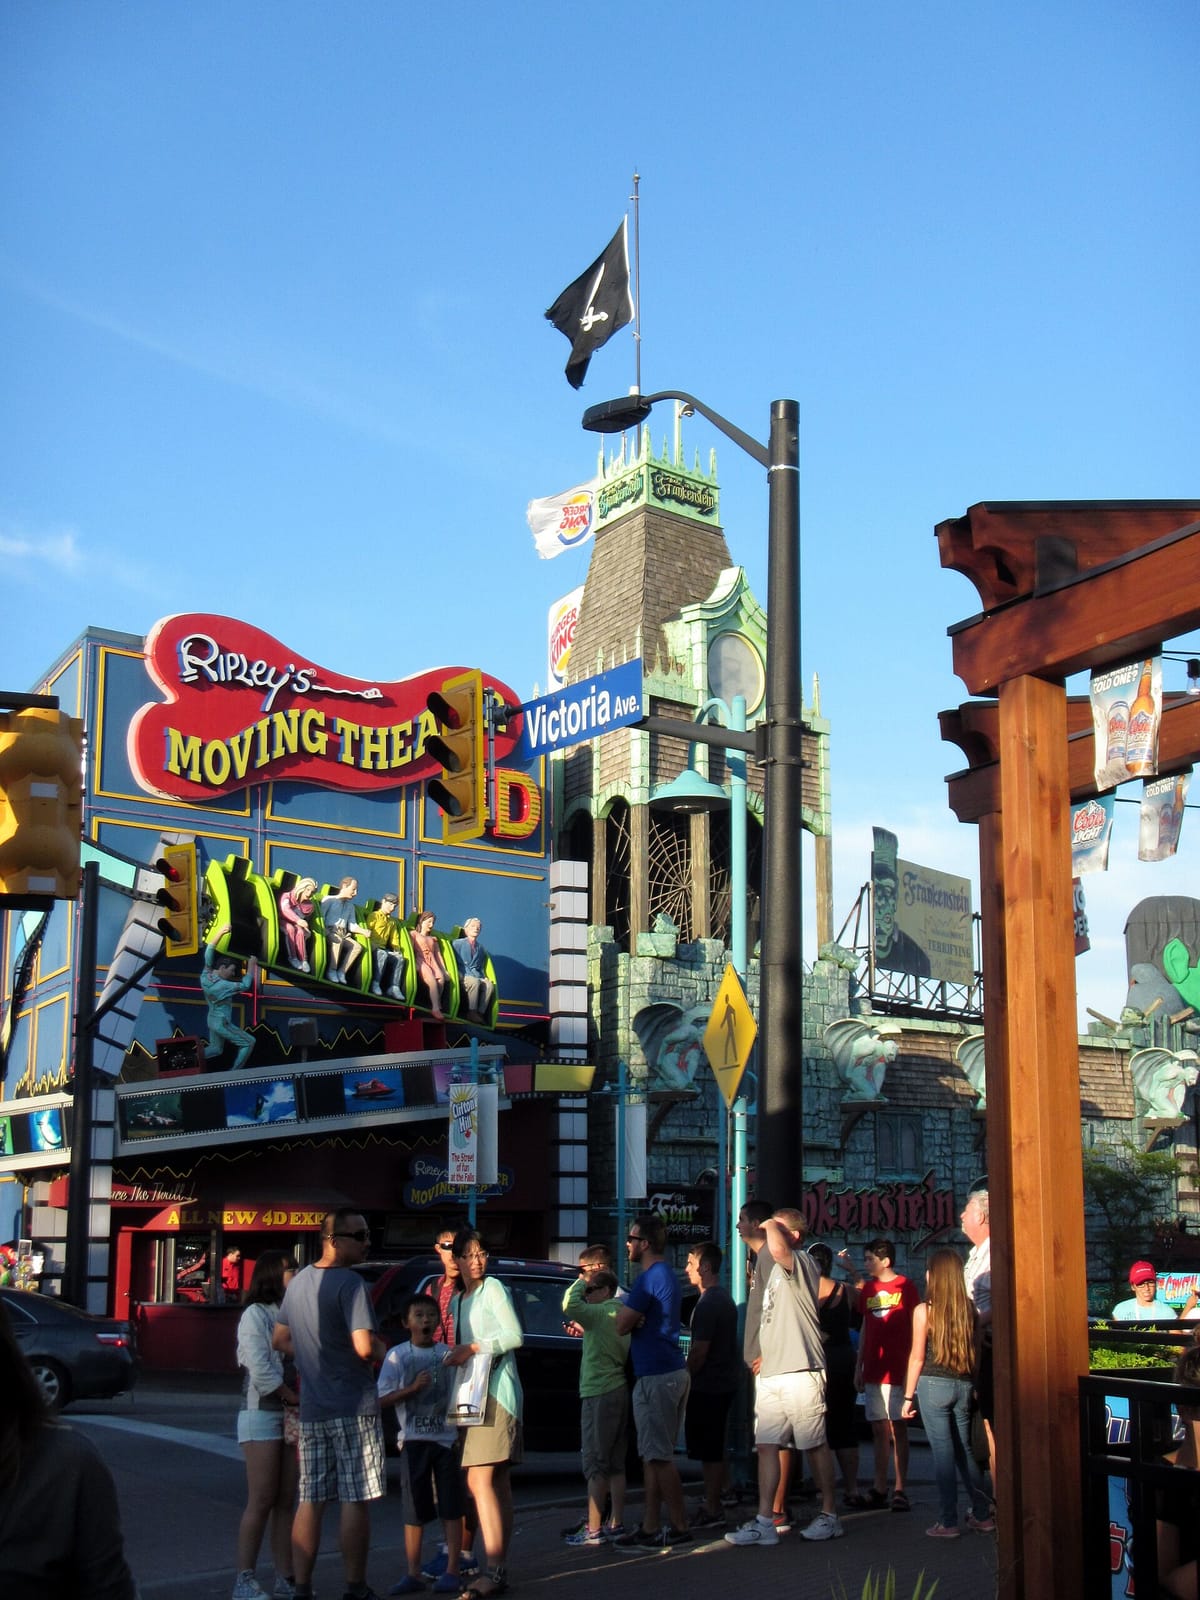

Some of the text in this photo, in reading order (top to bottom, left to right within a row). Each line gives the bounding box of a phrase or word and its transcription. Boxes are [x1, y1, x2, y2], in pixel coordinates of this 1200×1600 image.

[526, 684, 640, 749] Victoria Ave.
[166, 708, 328, 786] MOVING
[1074, 809, 1104, 832] Coors
[460, 1114, 472, 1132] Hill
[167, 1209, 328, 1226] ALL NEW 4D EXP
